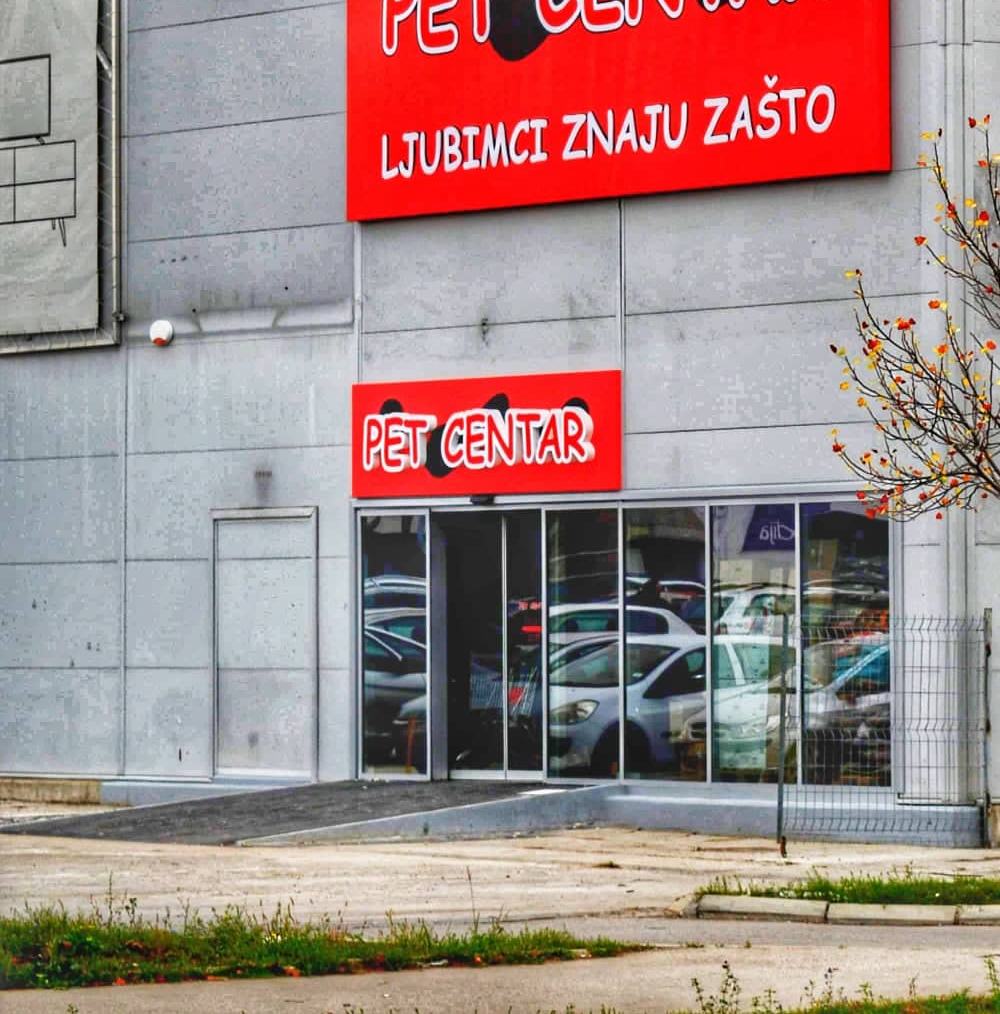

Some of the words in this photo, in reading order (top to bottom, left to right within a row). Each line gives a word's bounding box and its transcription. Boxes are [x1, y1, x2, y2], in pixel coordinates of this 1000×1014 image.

[382, 119, 547, 179] LJUBIMCI
[563, 102, 687, 160] ZNAJU
[704, 75, 834, 144] ZAŠTO
[363, 412, 437, 472] PET
[441, 406, 595, 469] CENTAR
